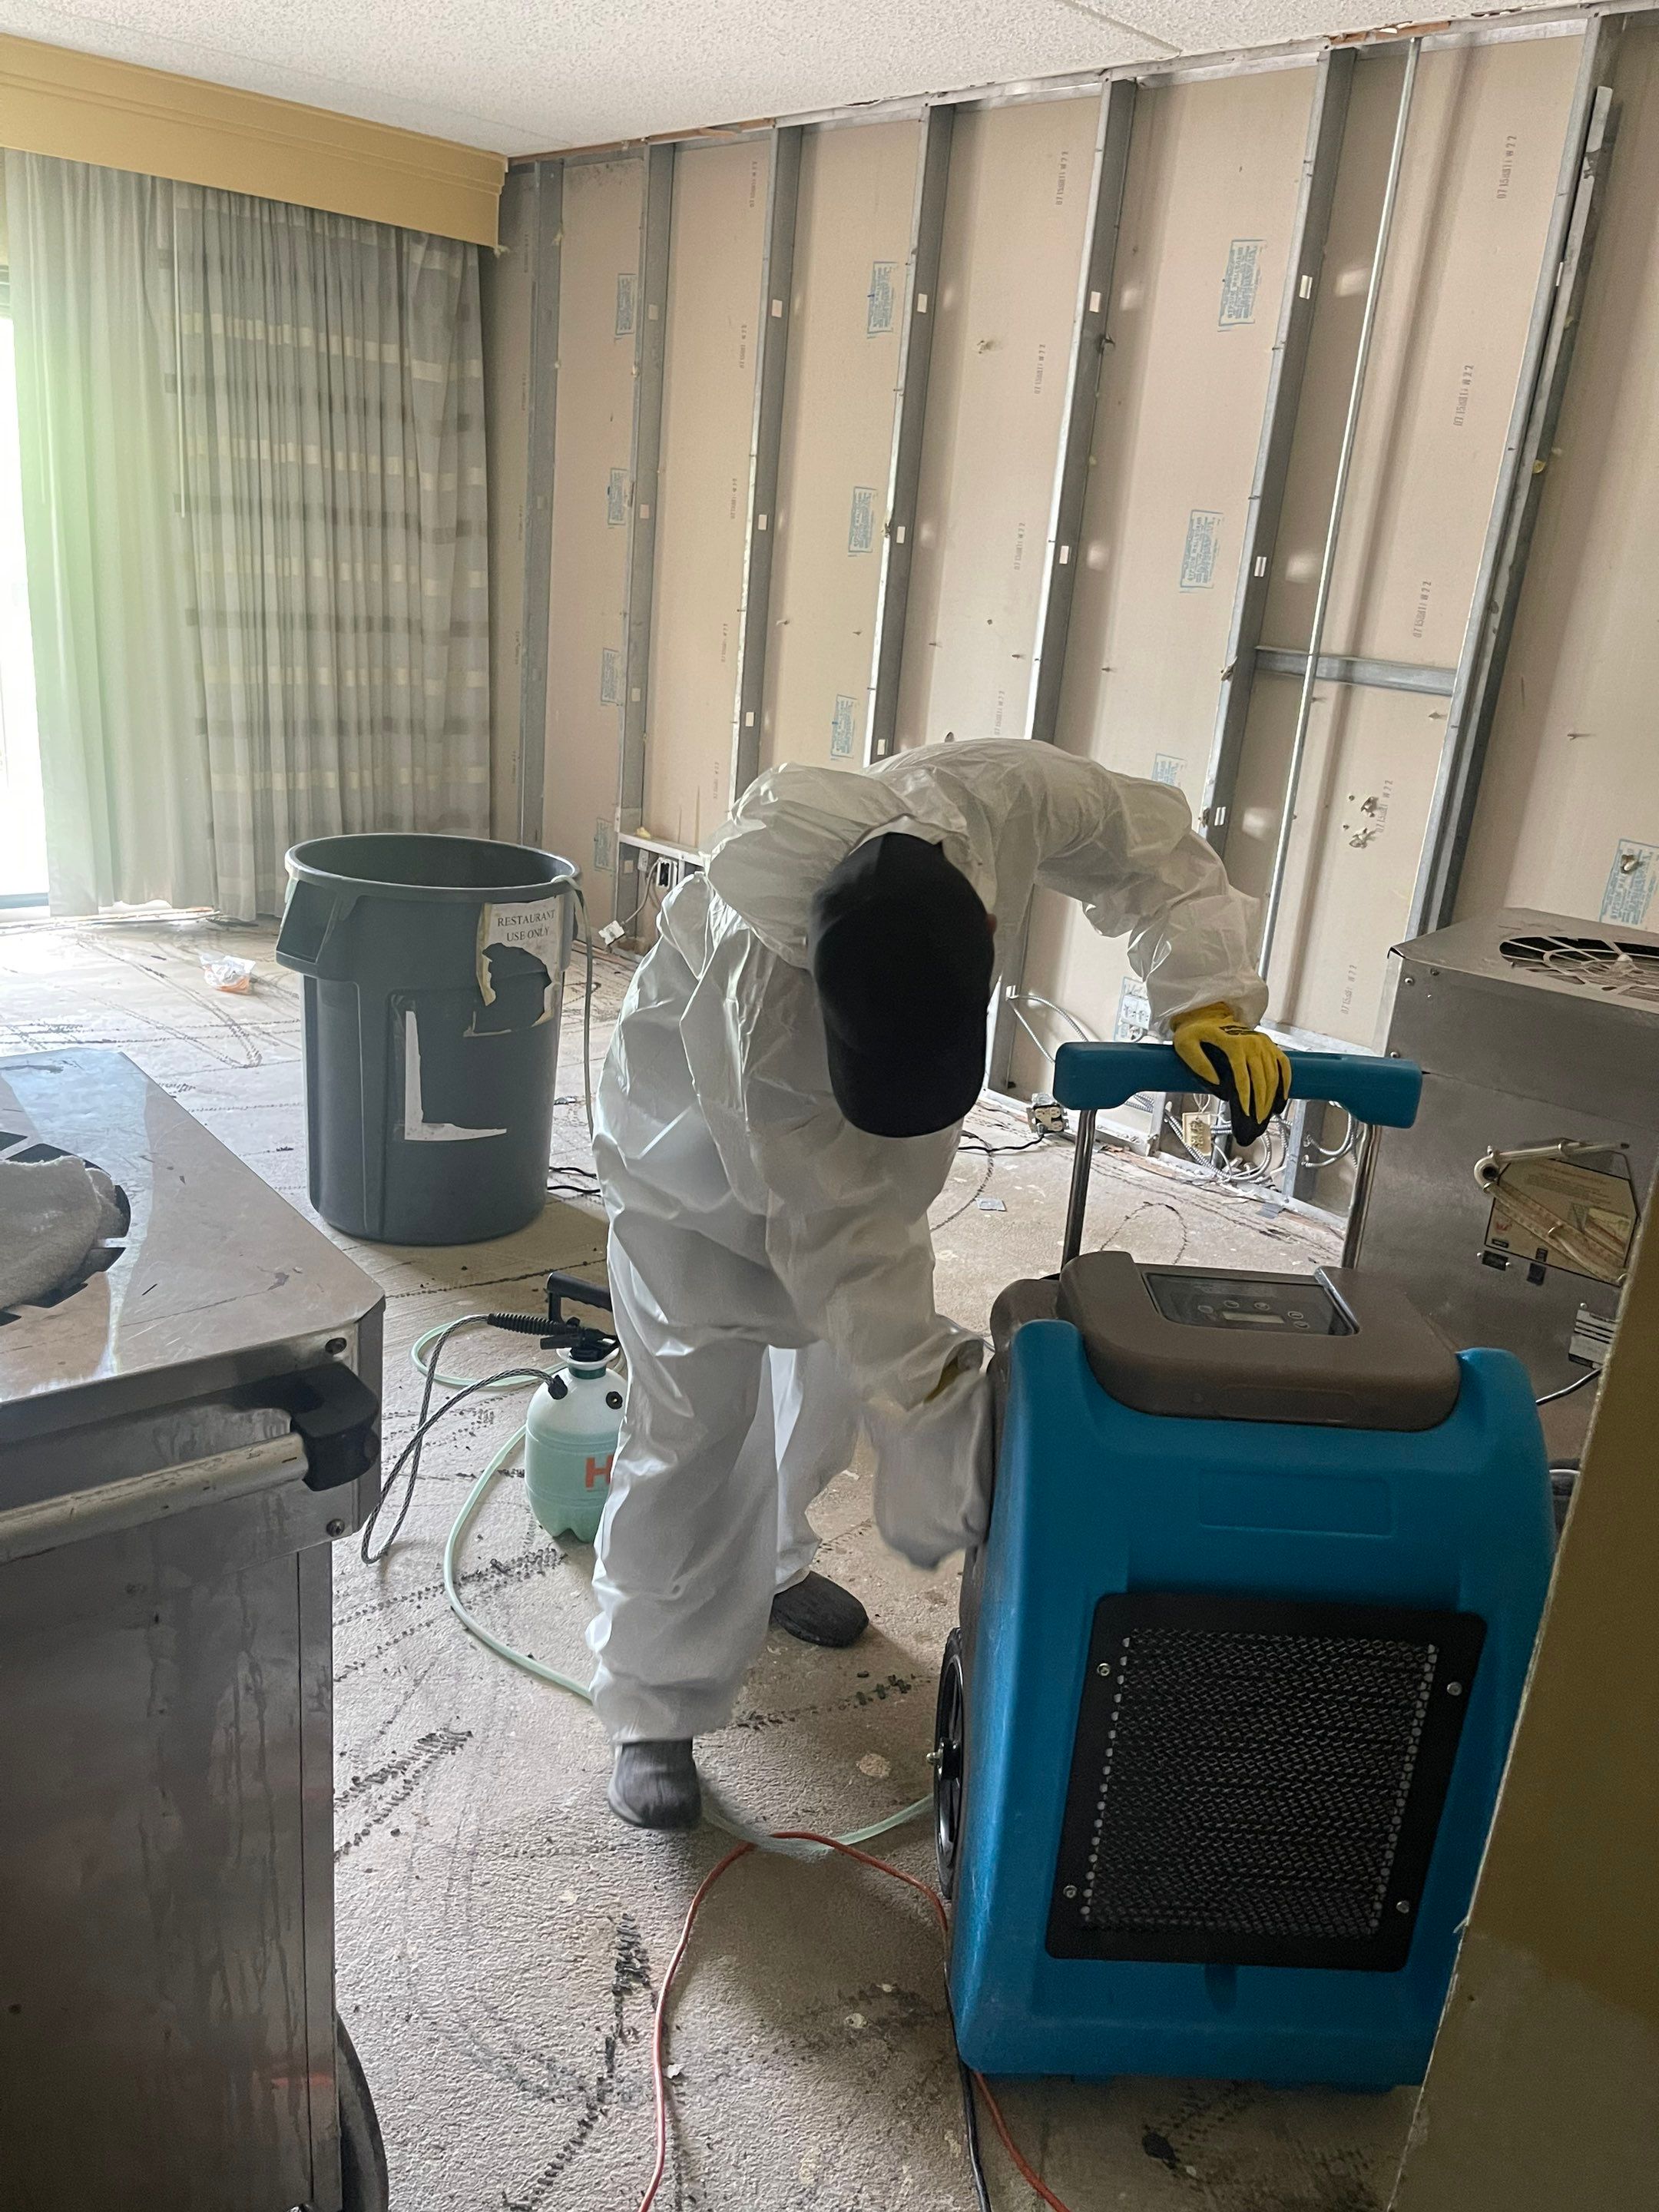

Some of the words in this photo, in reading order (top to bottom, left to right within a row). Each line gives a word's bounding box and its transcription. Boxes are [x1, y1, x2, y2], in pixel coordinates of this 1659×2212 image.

[497, 909, 555, 927] RESTAURANT
[506, 931, 525, 942] USE
[527, 926, 550, 939] ONLY
